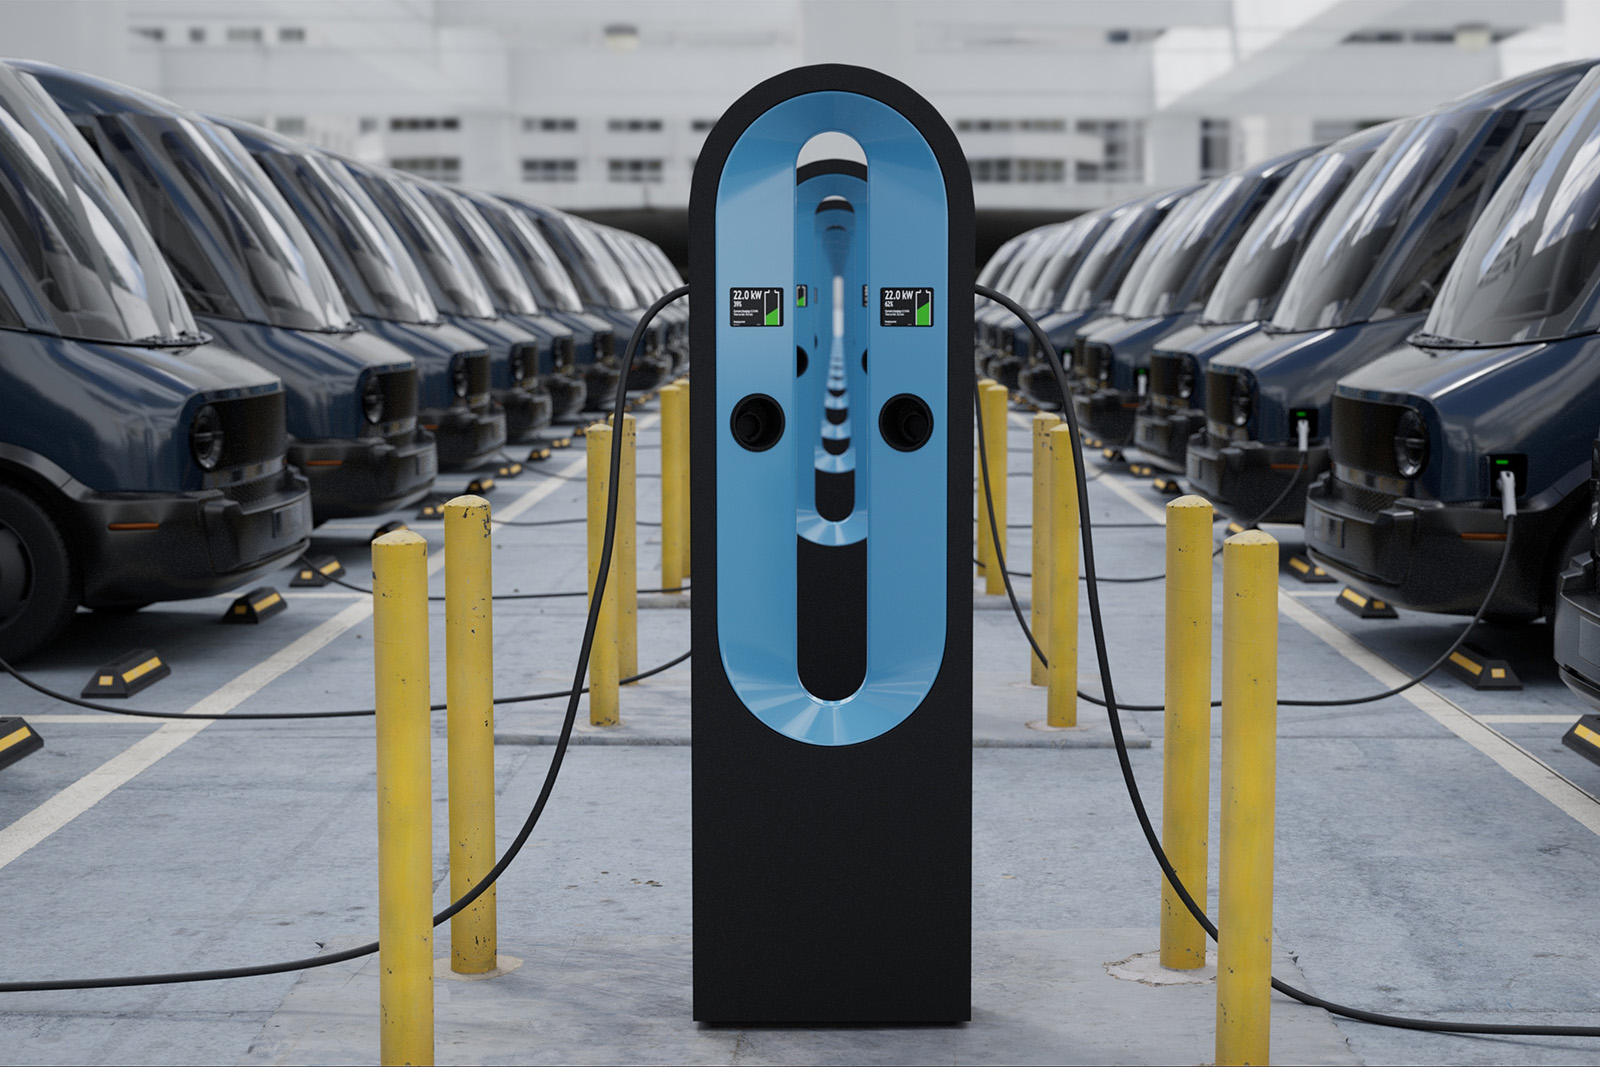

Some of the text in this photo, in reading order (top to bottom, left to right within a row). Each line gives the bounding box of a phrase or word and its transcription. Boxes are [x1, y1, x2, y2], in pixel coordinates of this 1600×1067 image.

[733, 290, 762, 300] 22.0 kW
[884, 290, 913, 300] 22.0 kW
